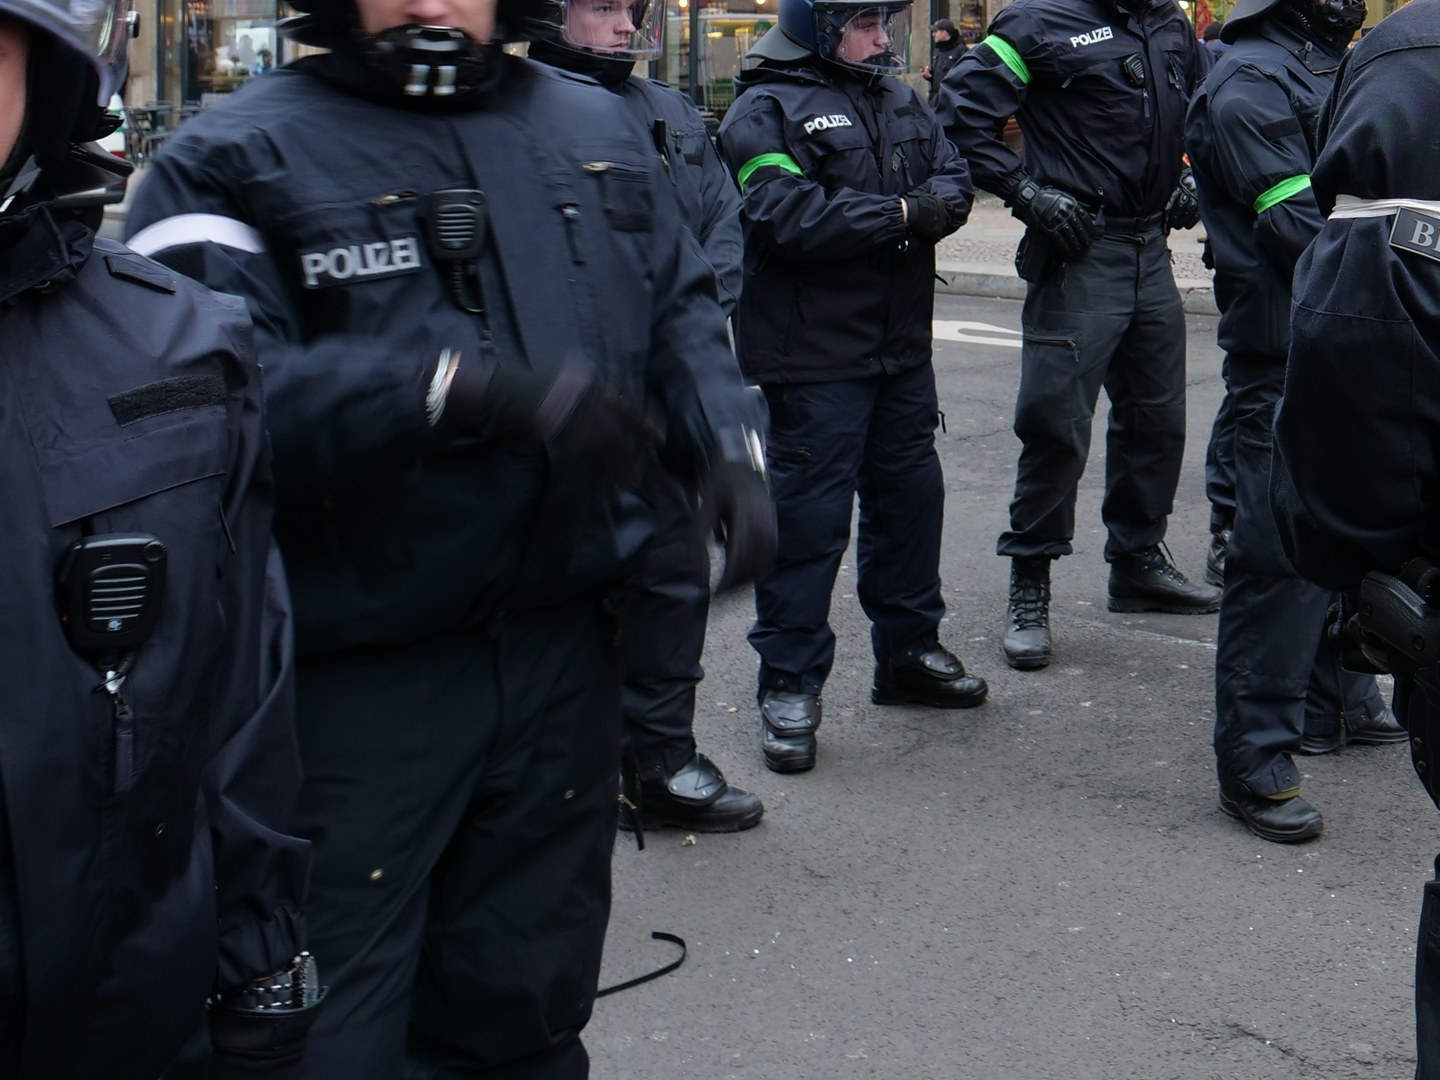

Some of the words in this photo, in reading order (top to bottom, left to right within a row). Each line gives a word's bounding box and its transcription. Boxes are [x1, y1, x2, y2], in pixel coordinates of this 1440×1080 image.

[1070, 26, 1114, 48] POLIZEI
[803, 114, 852, 135] POLIZEI
[301, 237, 422, 285] POLIZEI
